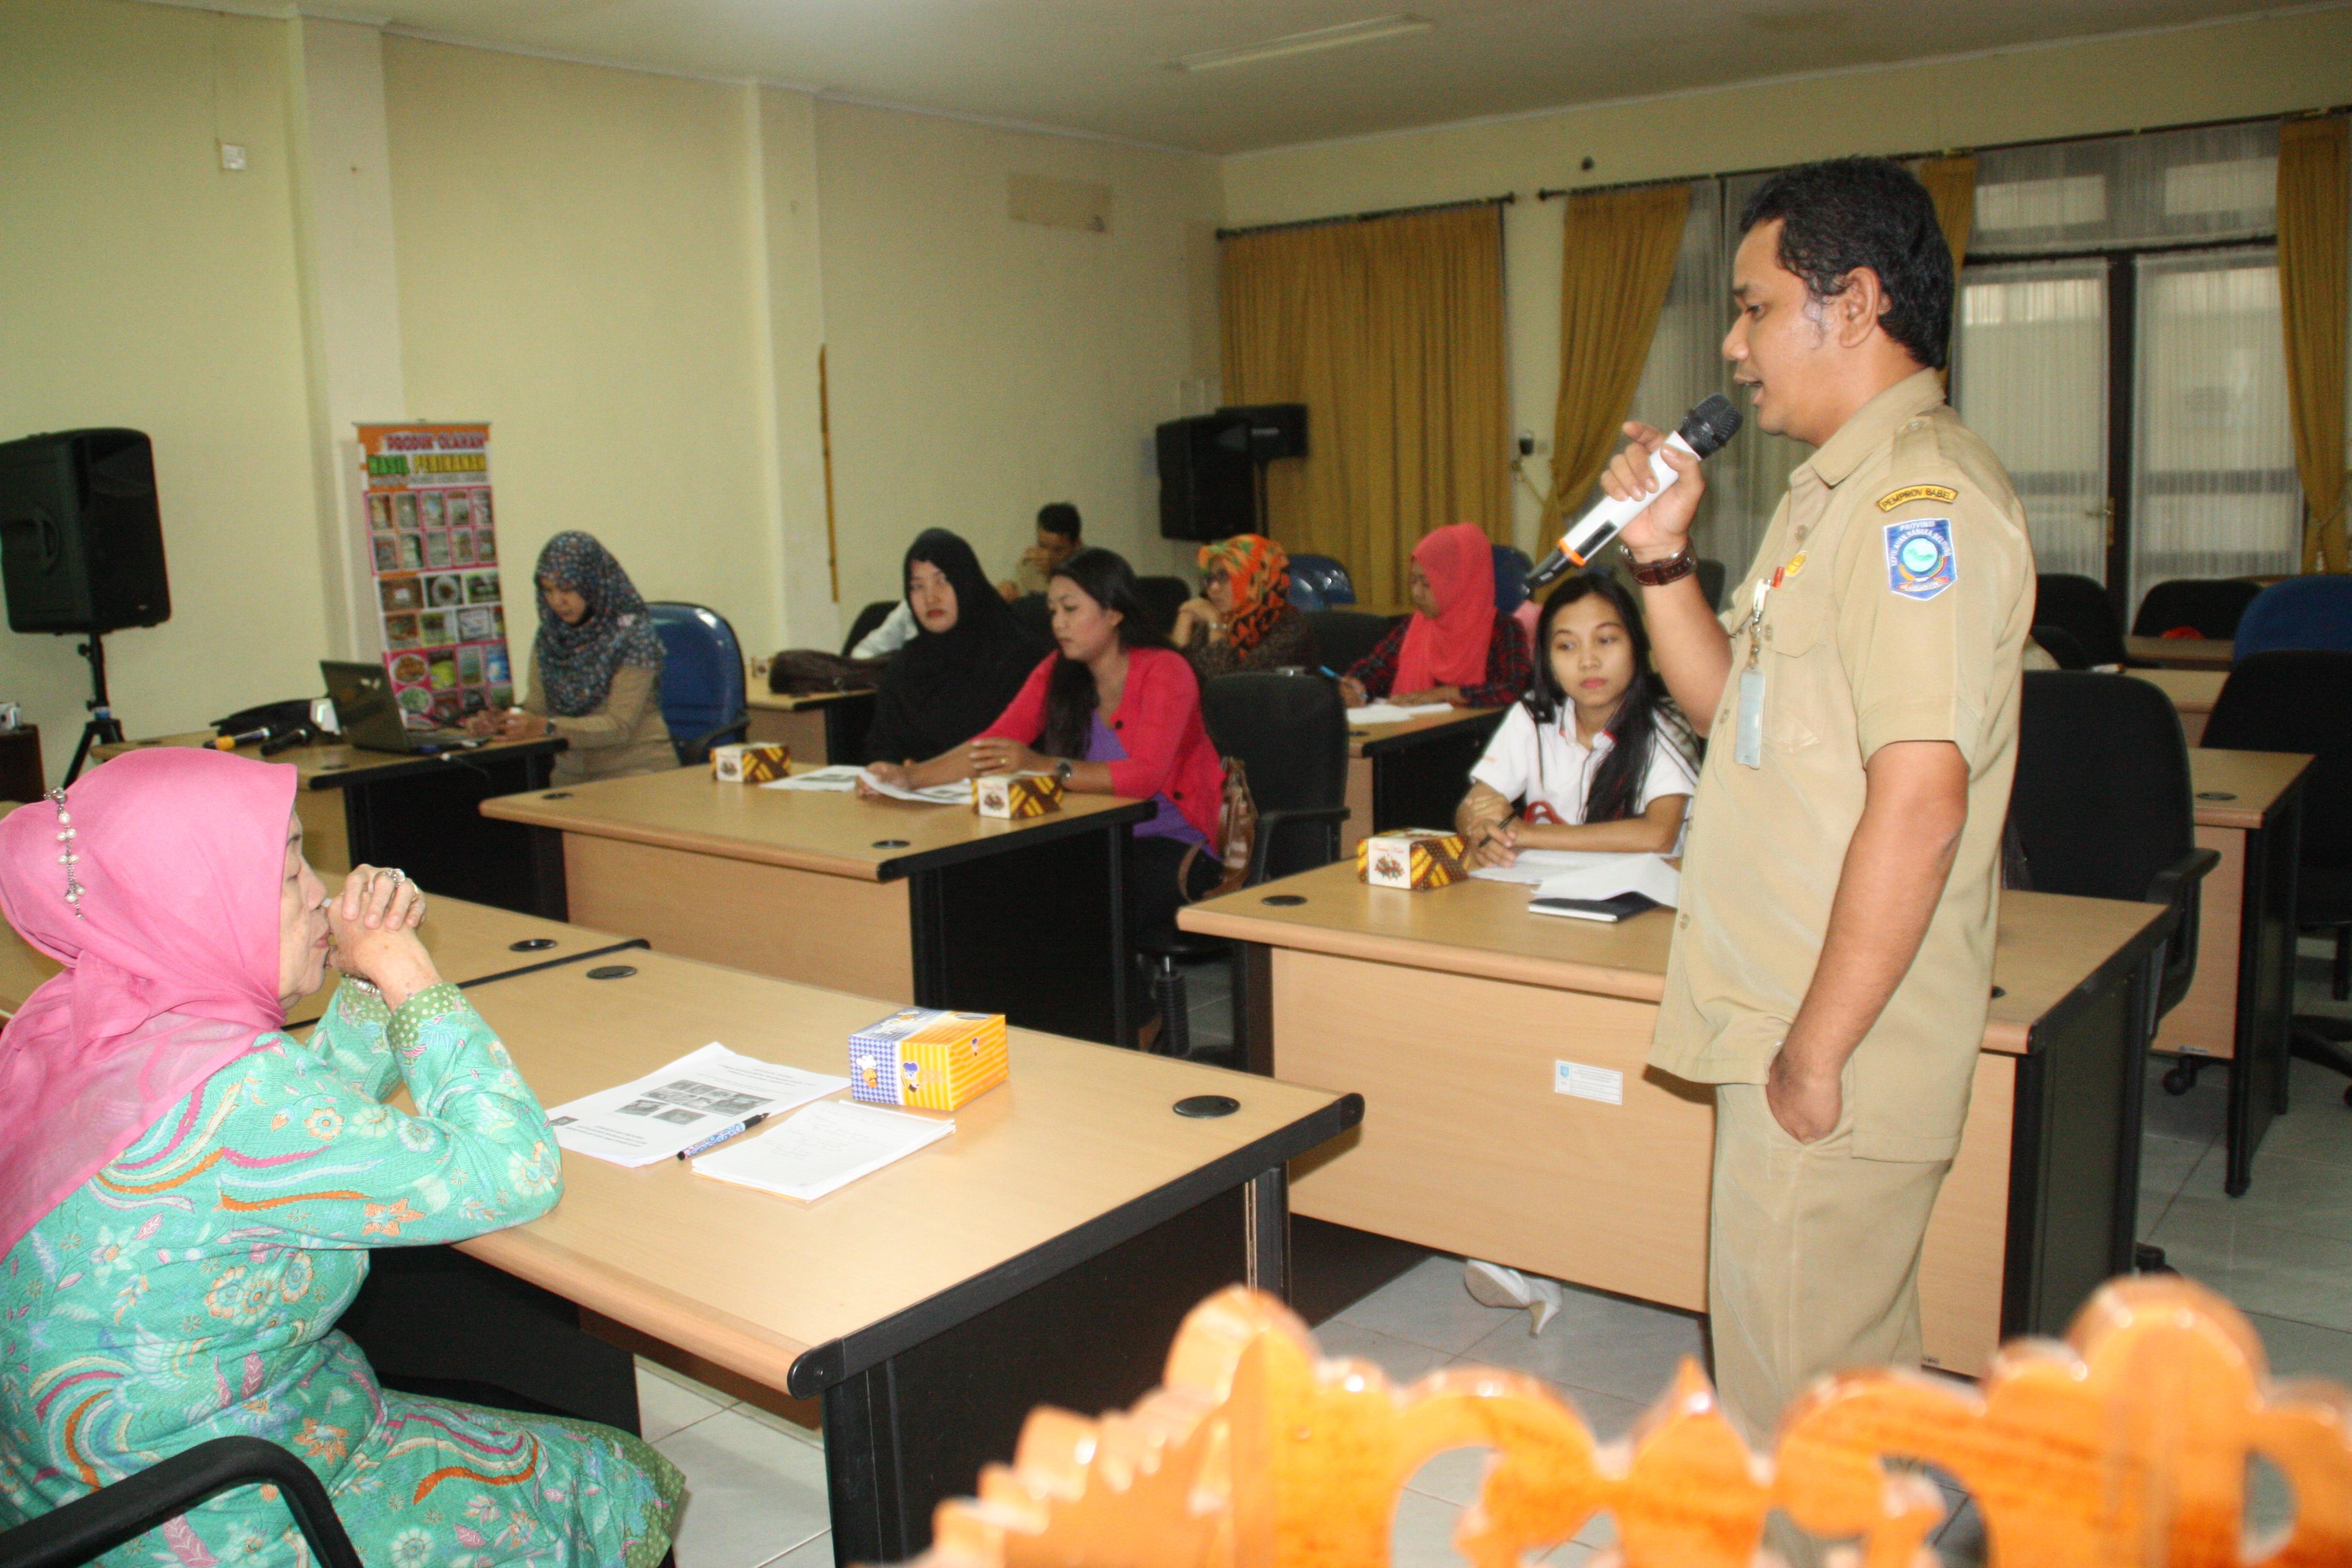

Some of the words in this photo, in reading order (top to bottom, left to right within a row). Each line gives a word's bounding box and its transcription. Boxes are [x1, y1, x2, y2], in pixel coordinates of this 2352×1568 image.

[367, 455, 411, 475] HASIL
[413, 453, 487, 473] PERIKANAN
[1882, 489, 1923, 508] PEMPROV
[1925, 488, 1951, 499] BABEL
[1901, 520, 1935, 531] PROVINSI
